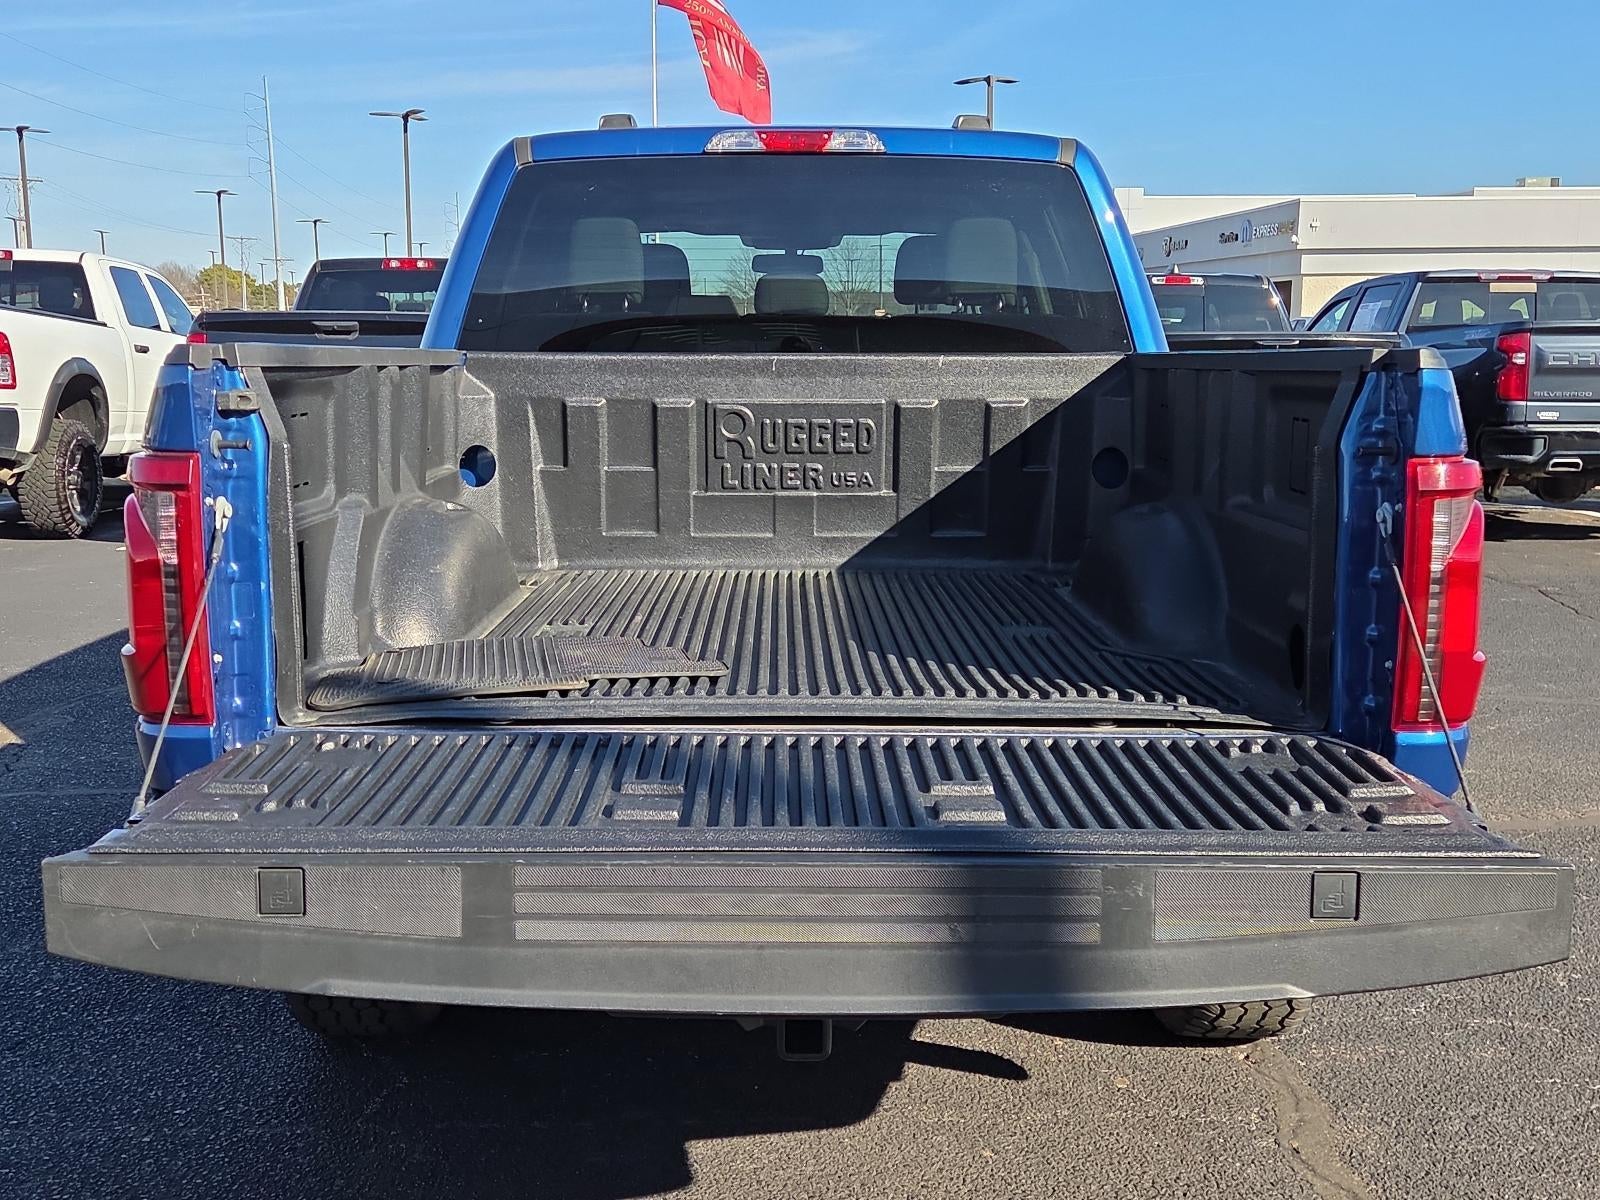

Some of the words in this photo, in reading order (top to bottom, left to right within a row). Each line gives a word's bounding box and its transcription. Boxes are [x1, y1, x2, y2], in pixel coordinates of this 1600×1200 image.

[1252, 223, 1279, 239] EXPRESS
[1548, 352, 1600, 366] CH
[714, 403, 877, 459] RUGGED
[721, 463, 824, 490] LINER
[830, 472, 874, 488] USA
